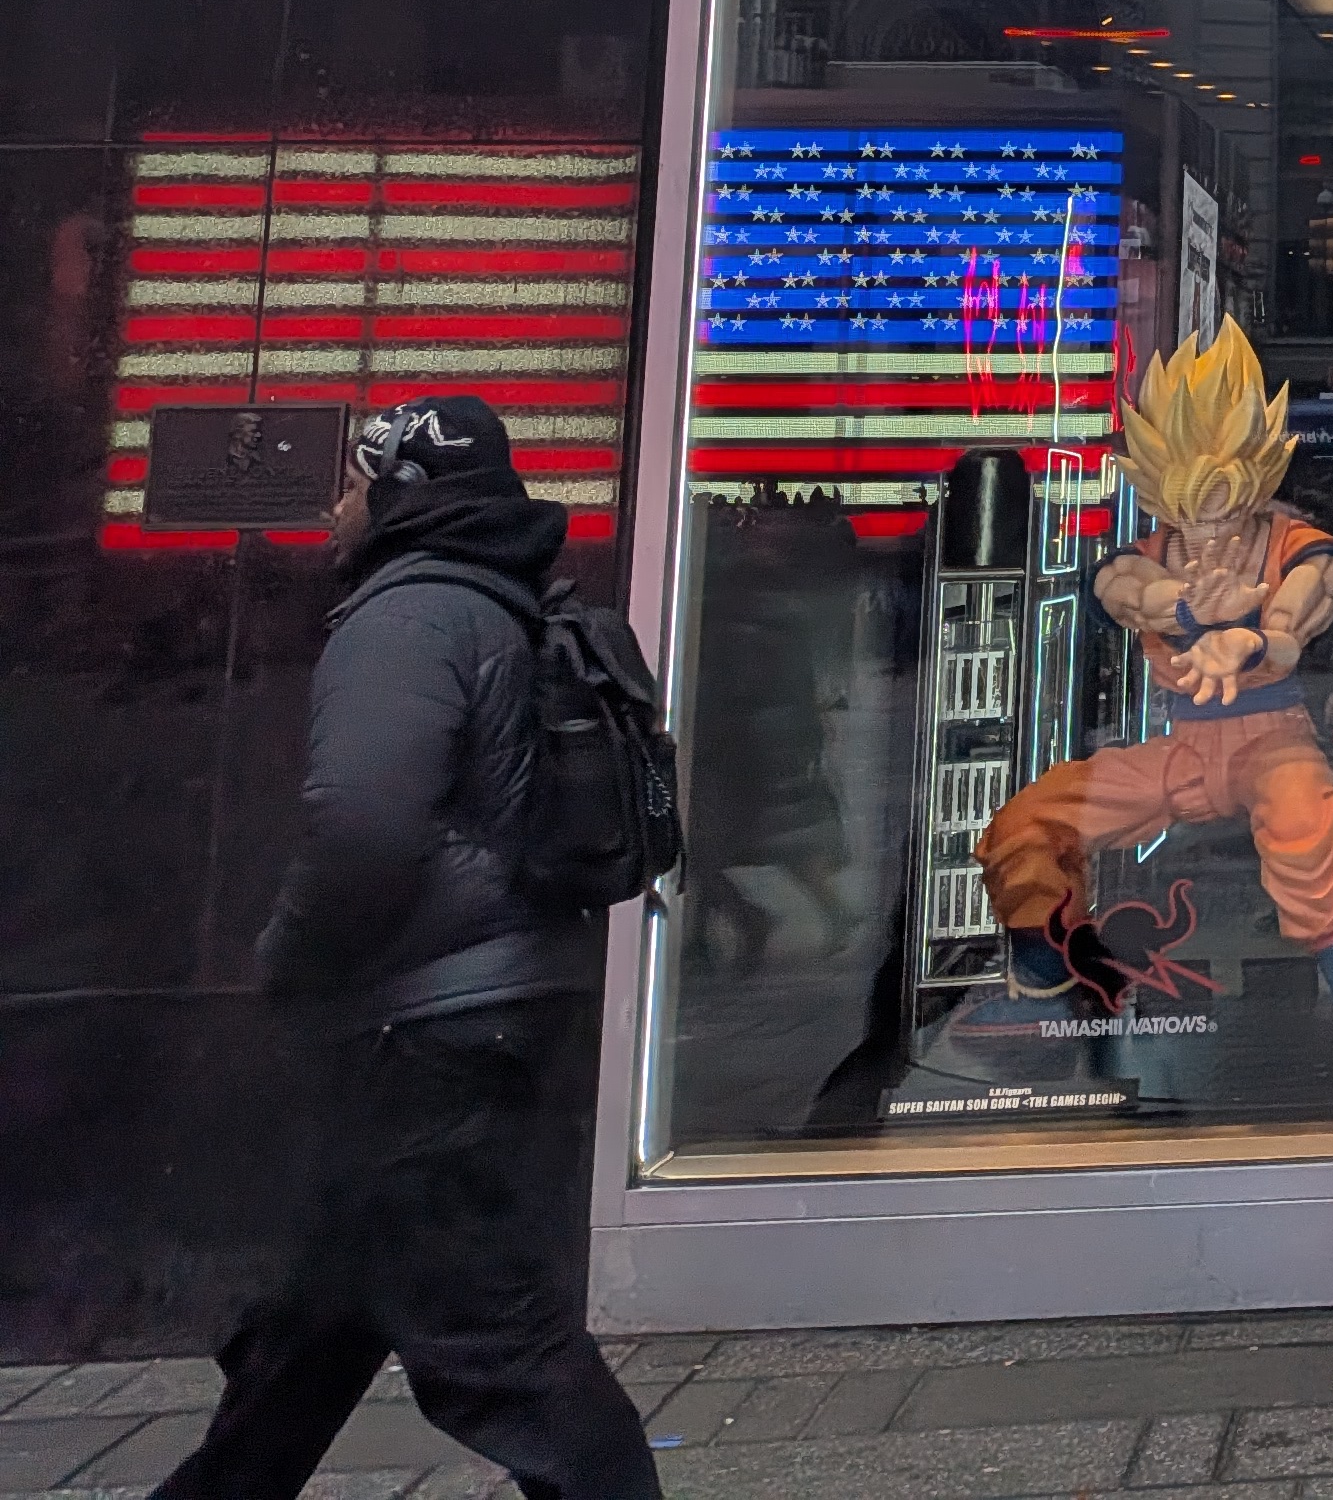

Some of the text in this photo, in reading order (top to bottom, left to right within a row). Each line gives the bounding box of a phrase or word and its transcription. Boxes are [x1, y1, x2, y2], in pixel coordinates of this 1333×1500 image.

[1039, 1018, 1122, 1038] TAMASHII
[889, 1101, 924, 1115] SUPER
[926, 1100, 965, 1113] SAIYAN
[966, 1099, 989, 1111] SON
[990, 1098, 1020, 1111] GOKU
[1050, 1094, 1087, 1108] GAMES
